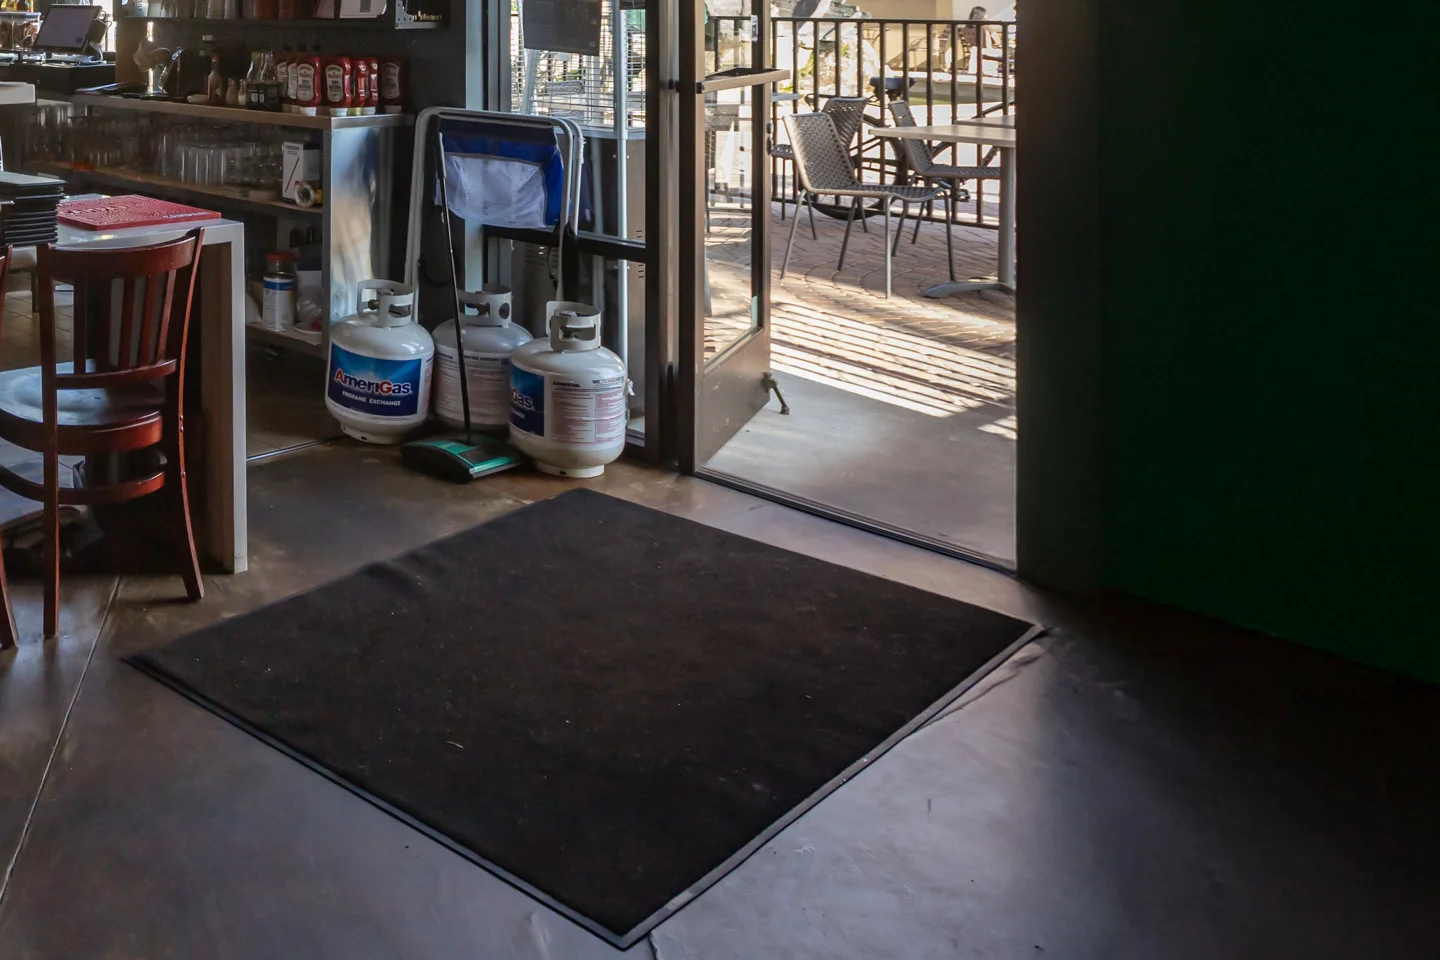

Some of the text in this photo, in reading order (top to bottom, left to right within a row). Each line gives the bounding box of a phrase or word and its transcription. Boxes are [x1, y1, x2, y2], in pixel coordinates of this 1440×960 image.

[334, 367, 412, 395] AmeriGas
[342, 390, 401, 406] PROPANE EXCHANGE
